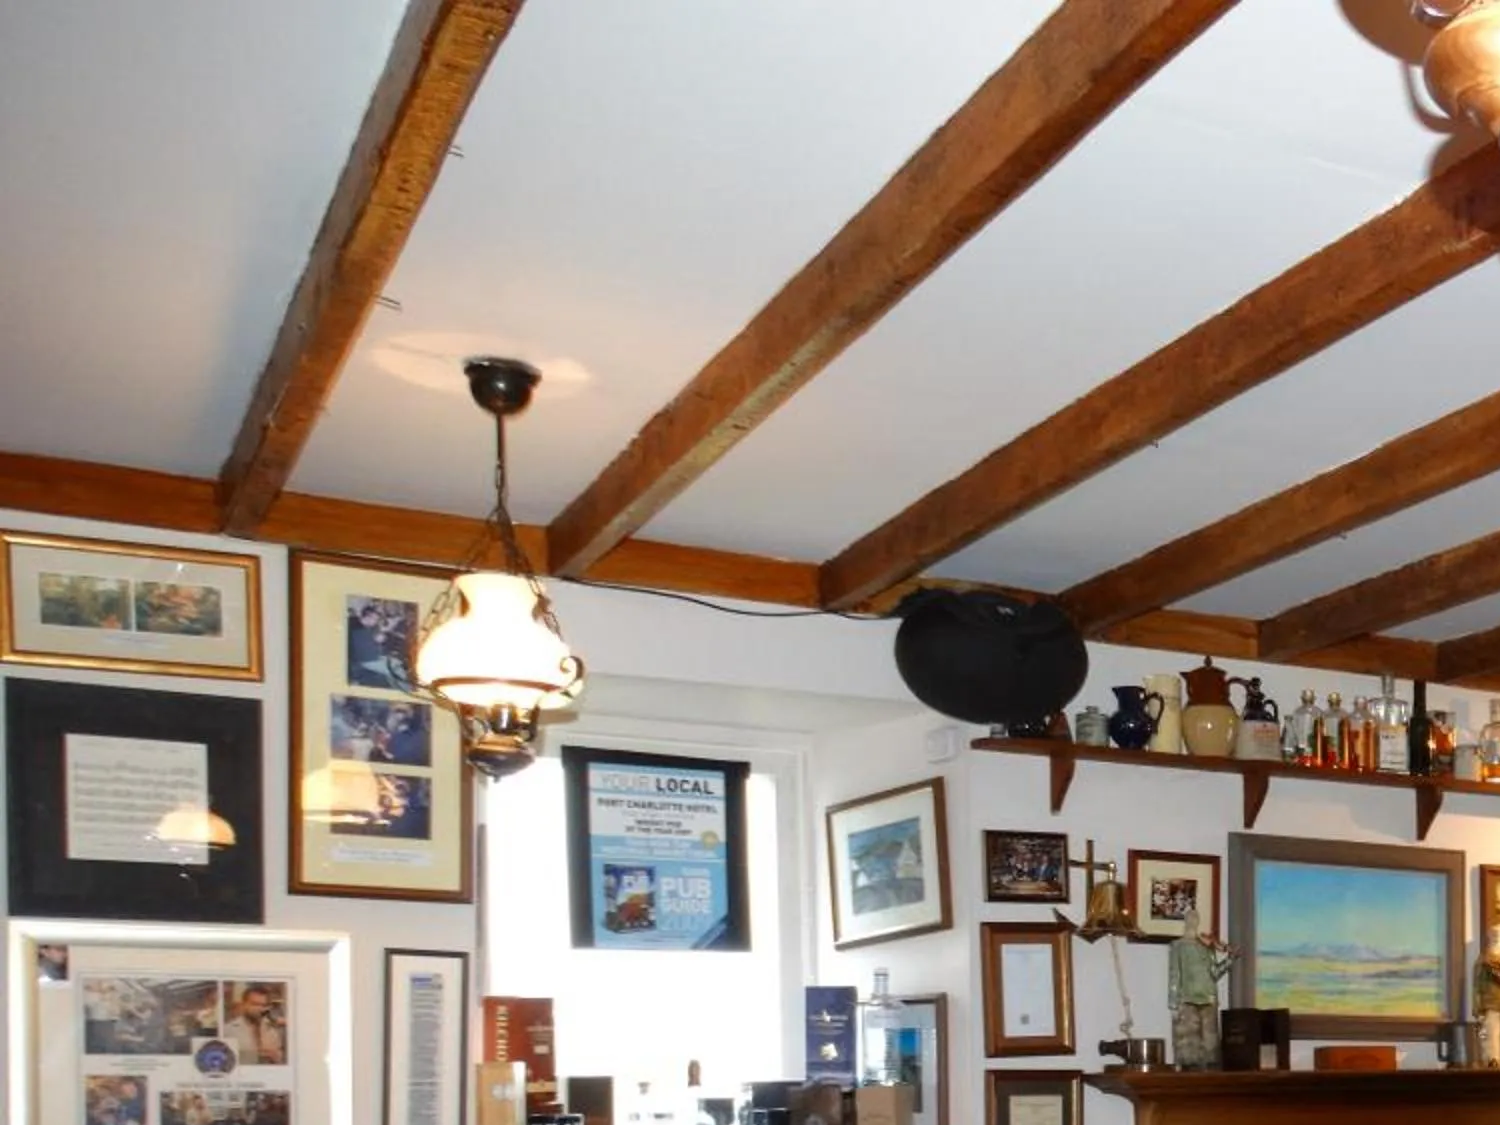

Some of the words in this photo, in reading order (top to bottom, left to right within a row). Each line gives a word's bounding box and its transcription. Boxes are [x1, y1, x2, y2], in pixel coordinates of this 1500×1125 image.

[601, 773, 649, 789] YOUR
[655, 778, 715, 795] LOCAL
[627, 800, 683, 811] CHARLOTTE
[660, 877, 711, 899] PUB
[660, 899, 712, 915] GUIDE
